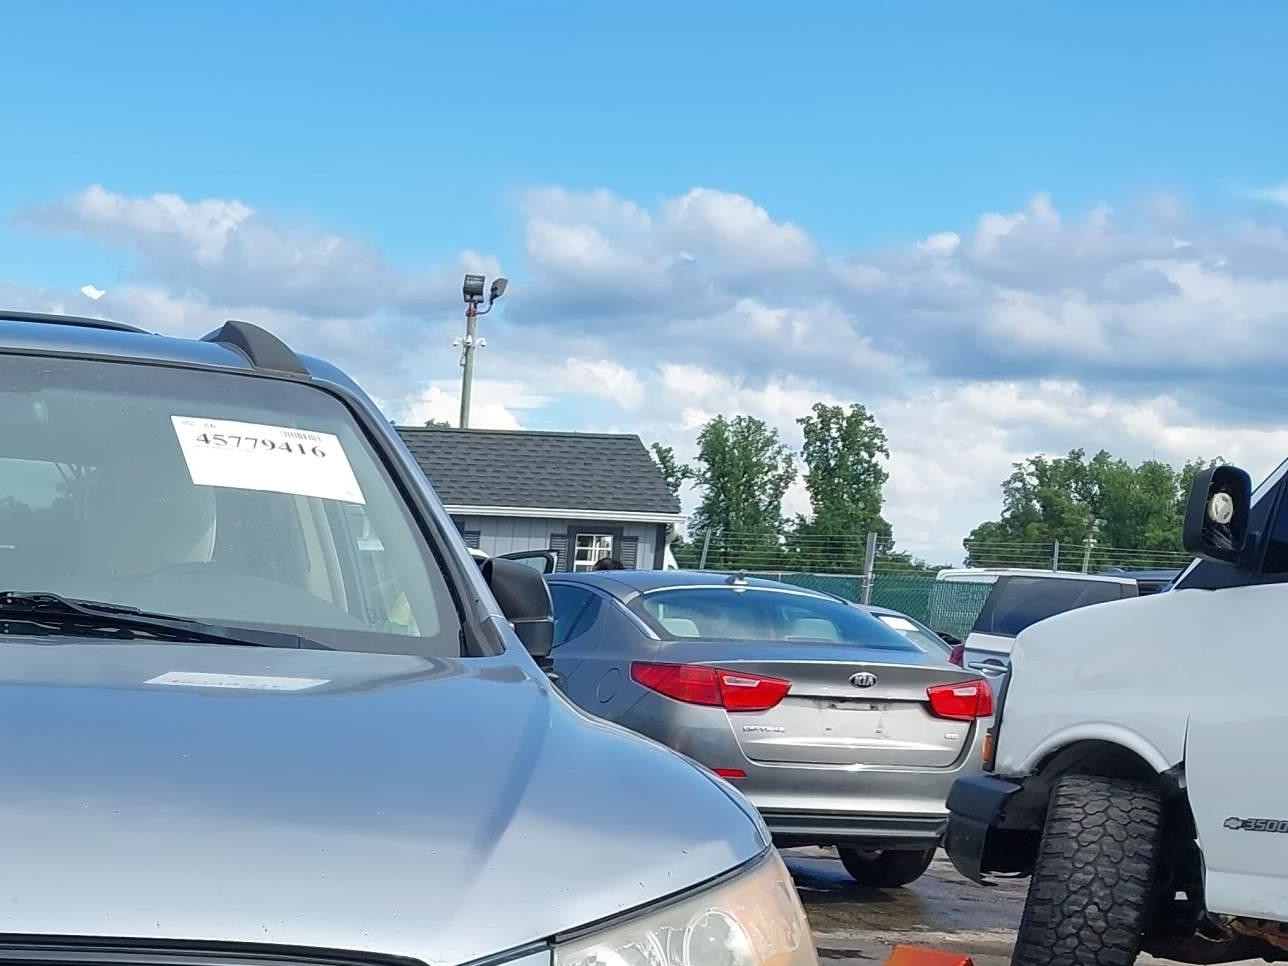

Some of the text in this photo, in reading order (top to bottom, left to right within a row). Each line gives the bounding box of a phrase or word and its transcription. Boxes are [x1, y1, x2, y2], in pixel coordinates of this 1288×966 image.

[196, 432, 327, 459] 45779416
[854, 676, 873, 686] KIA
[1243, 818, 1288, 833] 3500
